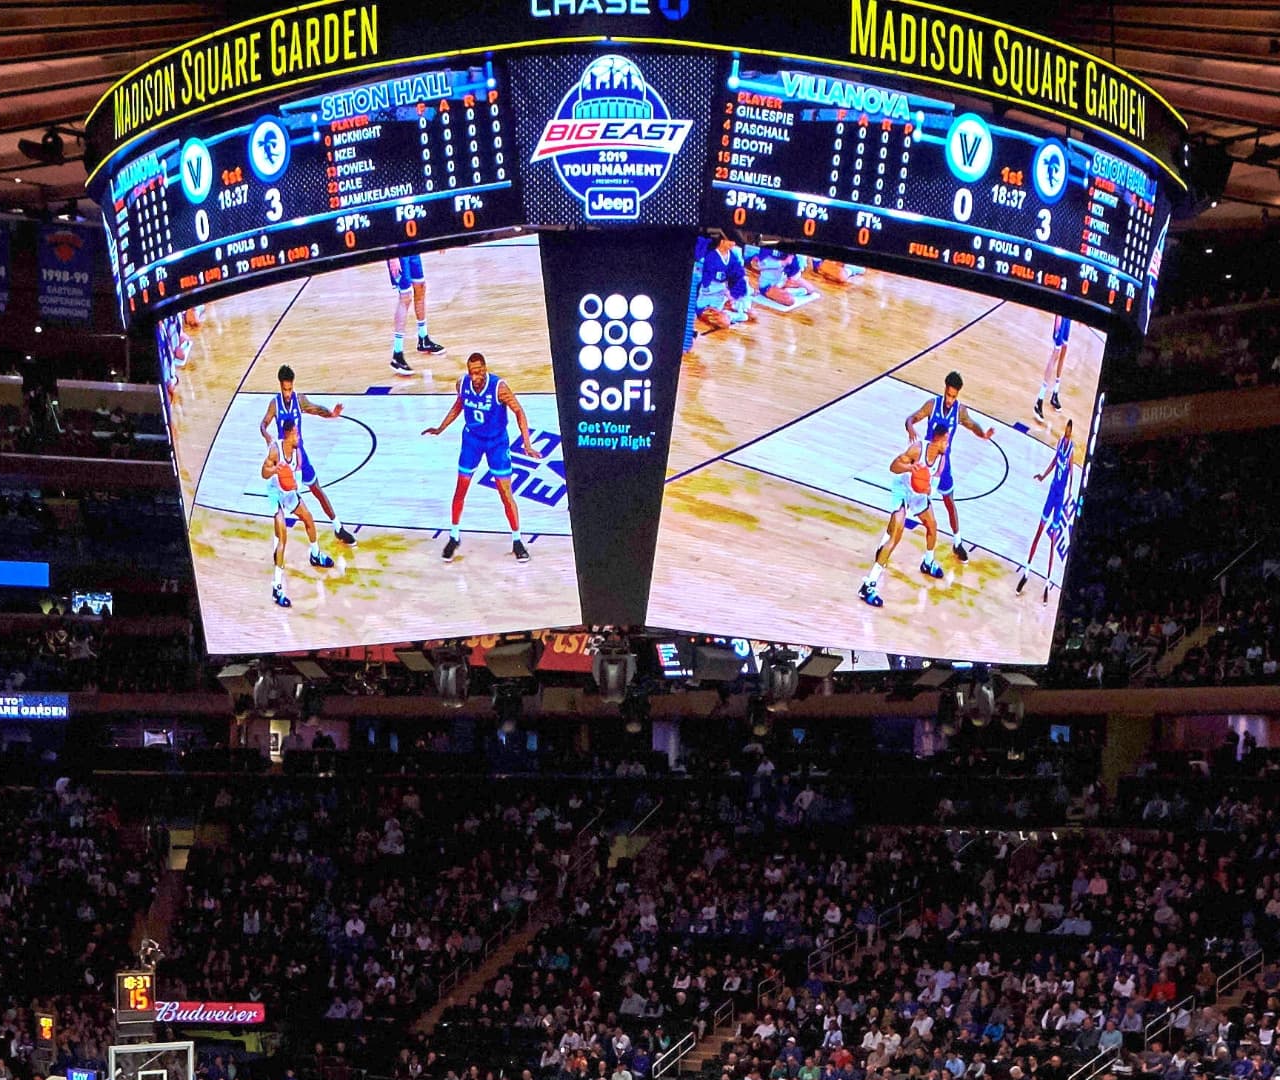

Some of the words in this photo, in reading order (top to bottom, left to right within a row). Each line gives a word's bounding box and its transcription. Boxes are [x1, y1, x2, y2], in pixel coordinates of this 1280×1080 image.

[531, 0, 651, 17] CHASE
[114, 63, 176, 140] MADISON
[180, 32, 262, 106] SQUARE
[270, 4, 379, 77] GARDEN
[850, 0, 983, 80] MADISON
[993, 28, 1078, 110] SQUARE
[1085, 60, 1146, 140] GARDEN
[322, 83, 393, 121] SETON
[393, 73, 454, 106] HALL
[737, 91, 783, 109] PLAYER
[781, 70, 910, 121] VILLANOVA
[725, 102, 733, 114] 2
[736, 105, 794, 126] GILLESPIE
[333, 125, 382, 147] MCKNIGHT
[735, 121, 791, 142] PASCHALL
[334, 146, 357, 162] NZEI
[733, 137, 773, 155] BOOTH
[598, 151, 628, 163] 2019
[731, 154, 755, 167] BEY
[222, 166, 244, 186] 1st
[336, 159, 376, 177] POWELL
[562, 164, 663, 177] TOURNAMENT
[338, 177, 363, 192] CALE
[729, 169, 782, 188] SAMUELS
[218, 184, 249, 210] 18:37
[340, 183, 413, 207] MAMUKELASHVI
[454, 194, 483, 213] FT%
[591, 194, 634, 213] Jeep
[726, 190, 767, 211] 3PT%
[991, 184, 1026, 209] 18:37
[265, 188, 283, 222] 3
[395, 204, 427, 222] FG%
[797, 202, 829, 221] FG%
[953, 188, 973, 222] 0
[195, 208, 210, 242] 0
[336, 213, 370, 233] 3PT%
[856, 211, 882, 230] FT%
[1035, 208, 1052, 242] 3
[227, 238, 256, 256] FOULS
[988, 238, 1020, 257] FOULS
[236, 260, 250, 273] TO
[908, 242, 939, 260] FULL:
[996, 260, 1009, 274] TO
[41, 269, 89, 284] 1998-99
[578, 421, 600, 433] Get
[601, 421, 631, 434] Your
[578, 435, 618, 450] Money
[21, 705, 66, 716] GARDEN
[123, 975, 150, 989] 18:37
[129, 988, 148, 1010] 15
[154, 1001, 258, 1023] Budweiser
